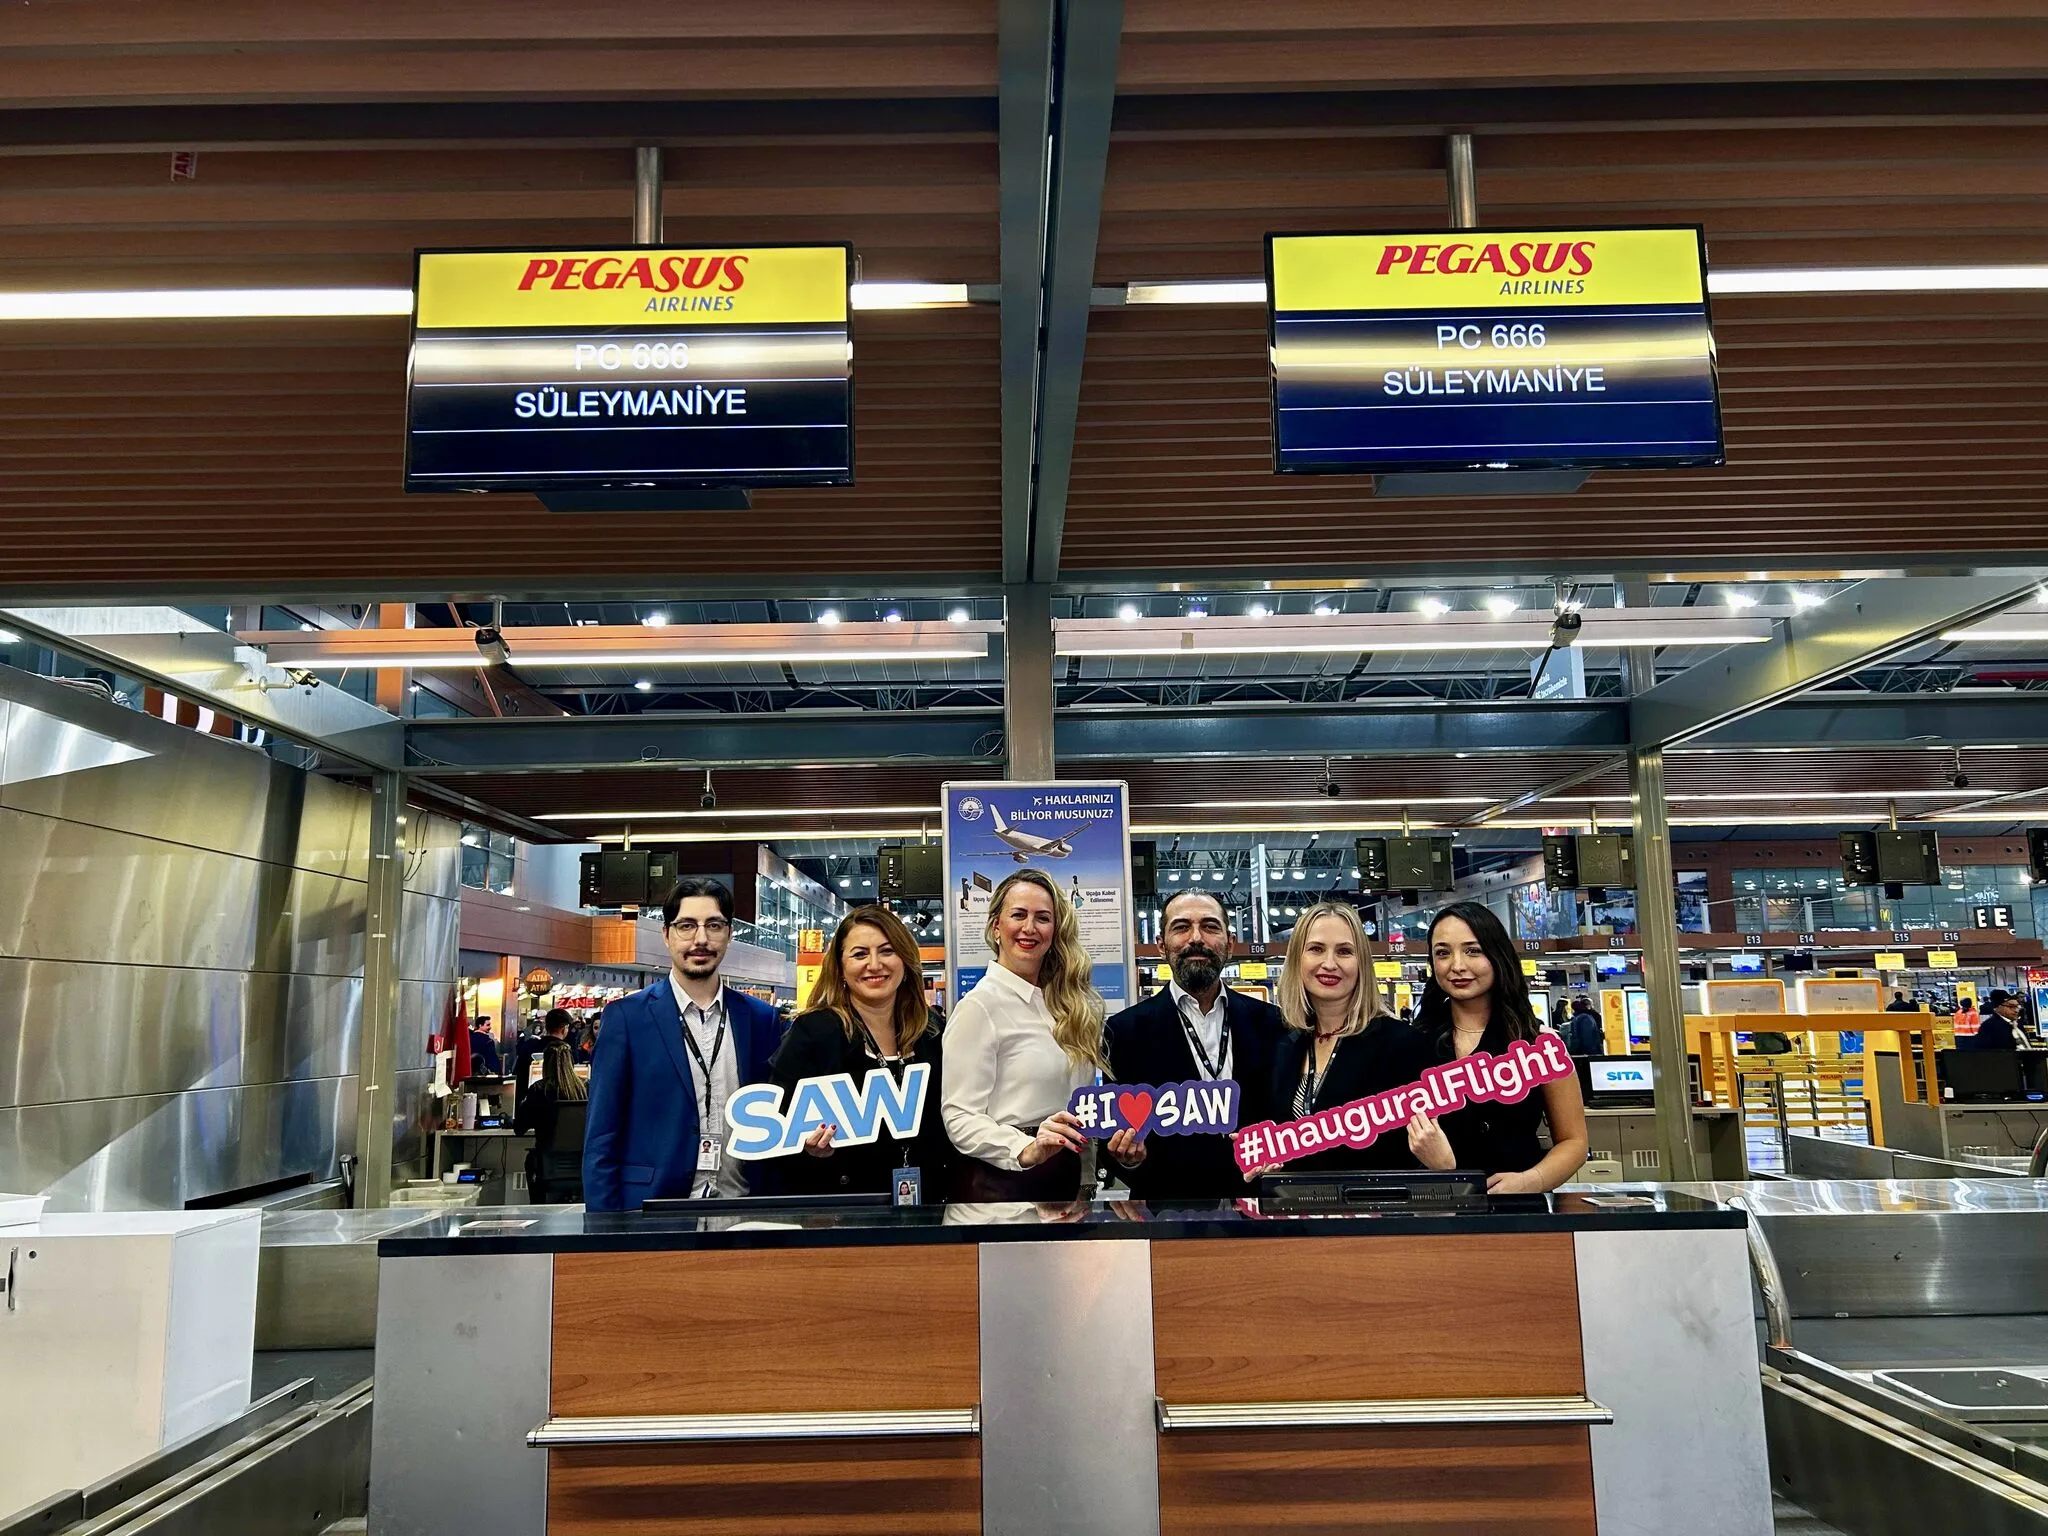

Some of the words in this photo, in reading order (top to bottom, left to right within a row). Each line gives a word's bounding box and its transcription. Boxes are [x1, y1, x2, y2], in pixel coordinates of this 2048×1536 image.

[1375, 241, 1595, 277] PEGASUS
[517, 255, 748, 293] PEGASUS
[1499, 279, 1585, 295] AIRLINES
[645, 296, 734, 312] AIRLINES
[1436, 325, 1481, 350] PC
[1491, 323, 1546, 349] 666
[574, 344, 621, 371] PC
[631, 342, 690, 370] 666
[1383, 362, 1606, 396] SÜLEYMANİYE
[515, 385, 747, 418] SÜLEYMANİYE
[1045, 794, 1114, 805] HAKLARINIZI
[1010, 809, 1052, 821] BİLİYOR
[1054, 809, 1114, 820] MUSUNUZ?
[1994, 907, 2009, 927] E
[1610, 938, 1625, 946] E11
[1746, 935, 1761, 944] E13
[1799, 935, 1814, 944] E14
[1894, 933, 1909, 942] E15
[1943, 932, 1959, 941] E16
[1251, 945, 1265, 954] E06
[1525, 942, 1540, 951] E10
[531, 974, 548, 982] ATM
[531, 984, 547, 992] ATM
[1607, 1071, 1644, 1081] SITA
[1155, 1086, 1232, 1128] SAW
[1239, 1039, 1568, 1167] #InauguralFlight
[732, 1069, 924, 1154] SAW
